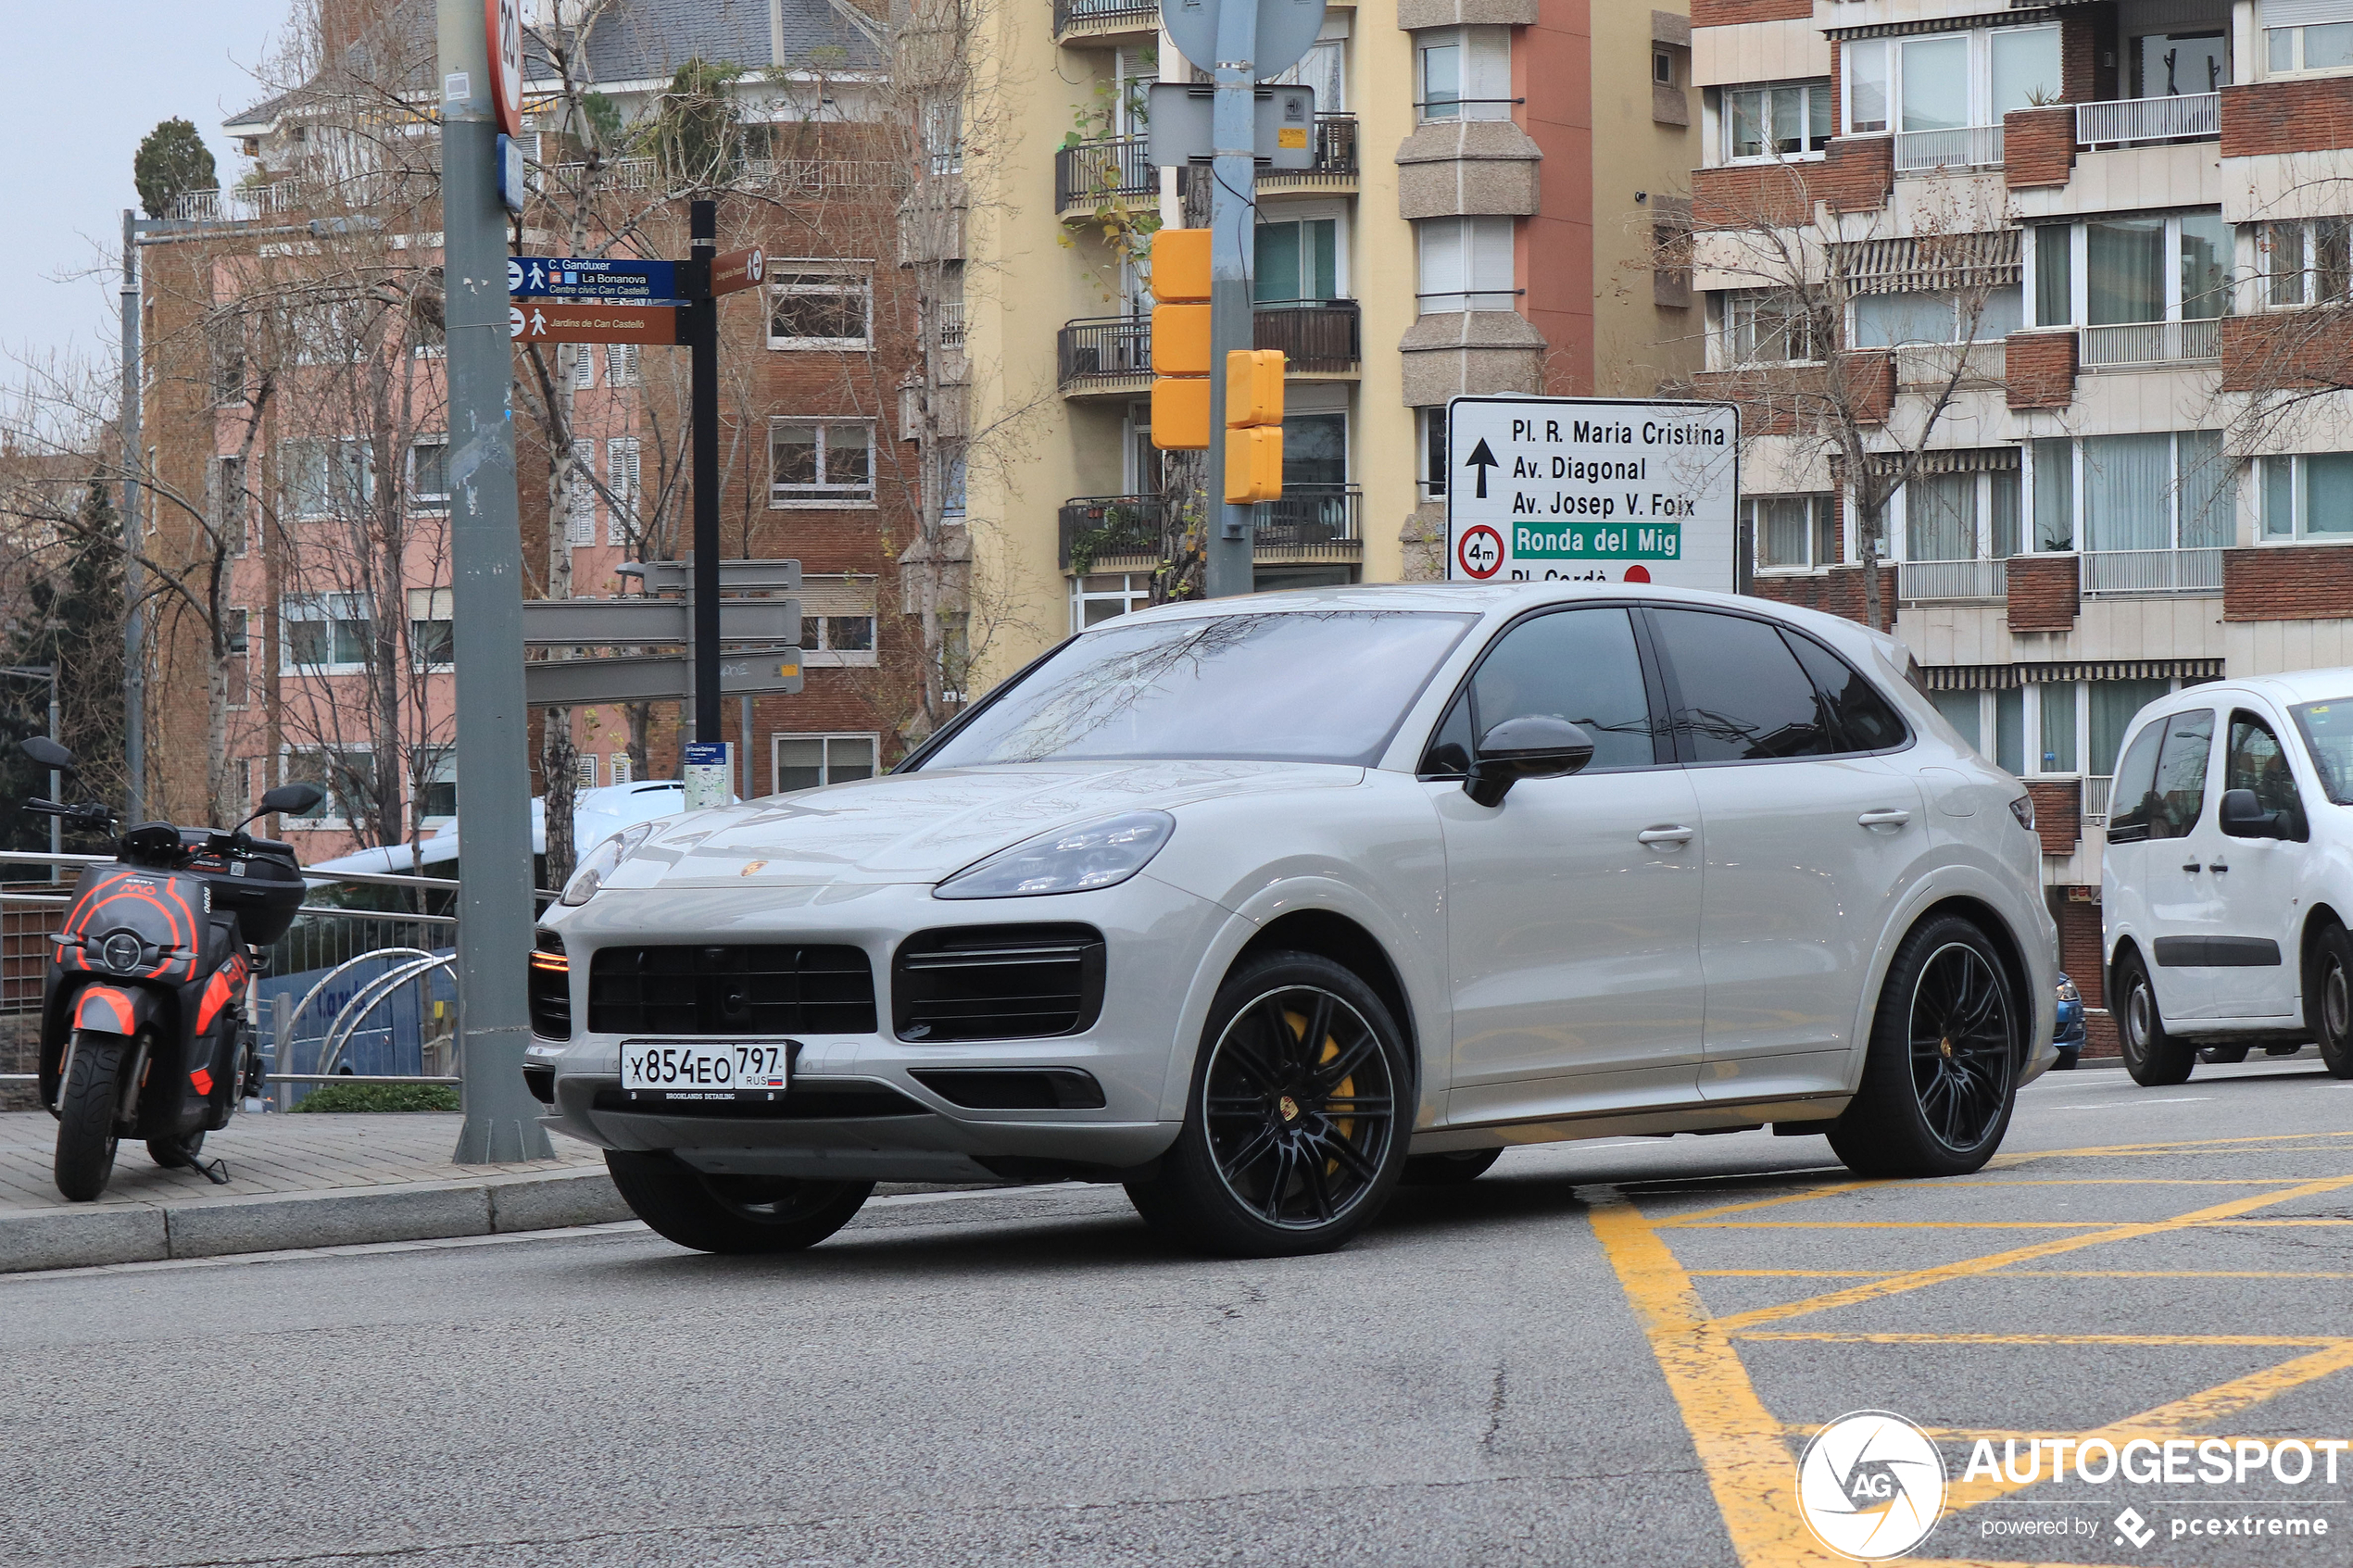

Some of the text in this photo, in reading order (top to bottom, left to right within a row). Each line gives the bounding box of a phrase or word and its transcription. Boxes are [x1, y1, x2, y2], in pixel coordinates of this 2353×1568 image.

[548, 259, 610, 270] C. Ganduxer
[582, 273, 595, 283] La
[598, 273, 647, 284] Bonanova
[548, 284, 576, 294] Centre
[598, 285, 615, 295] Can
[617, 285, 649, 295] Castelló
[581, 319, 592, 328] de
[594, 319, 610, 328] Can
[612, 319, 645, 329] Castelló
[1513, 420, 1724, 445] Pl. R. Maria Cristina
[1513, 456, 1645, 483] Av. Diagonal
[1512, 491, 1695, 520] Av. Josep V. Foix
[1516, 527, 1677, 556] Ronda del Mig
[736, 1047, 779, 1074] 797
[746, 1076, 768, 1085] RUS
[665, 1092, 703, 1100] BROOKLANDS
